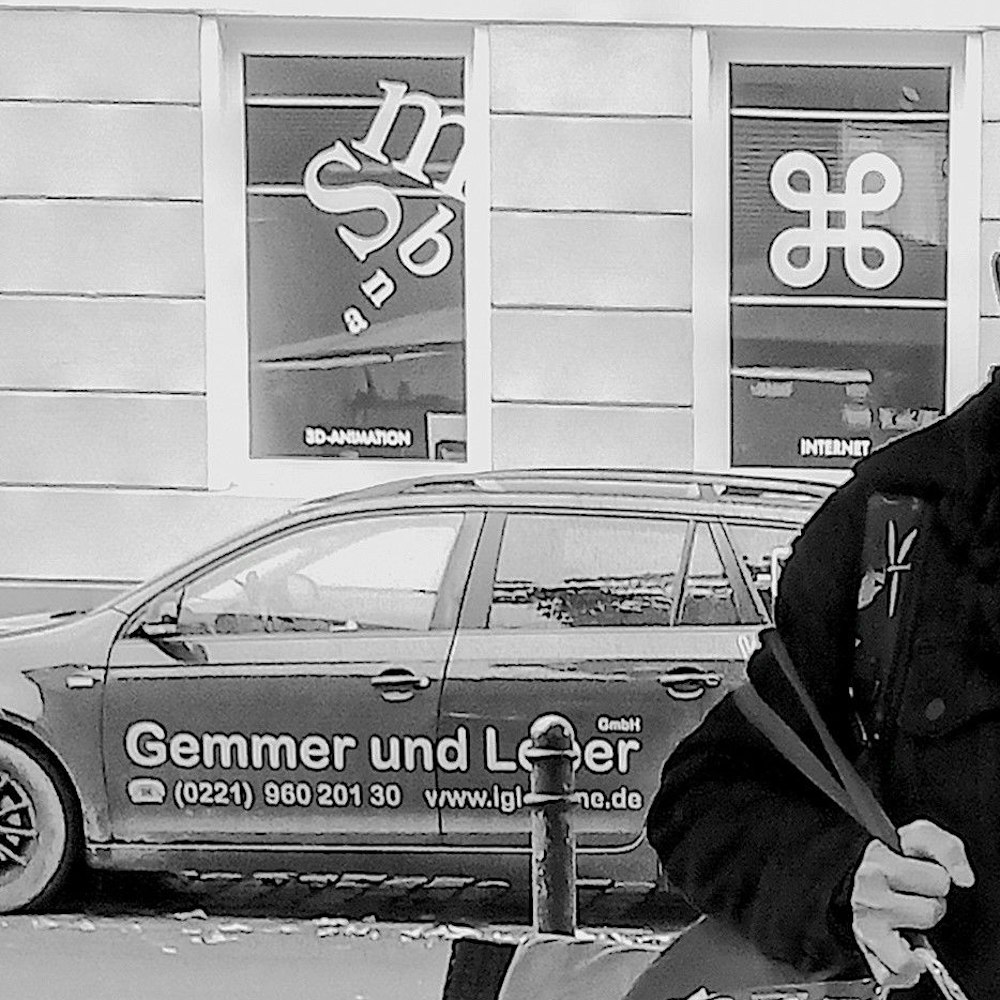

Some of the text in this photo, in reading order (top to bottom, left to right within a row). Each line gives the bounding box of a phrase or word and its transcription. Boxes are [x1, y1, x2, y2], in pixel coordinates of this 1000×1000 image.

[304, 426, 412, 446] 3D-ANIMATION
[800, 438, 871, 457] INTERNET
[597, 715, 642, 733] GmbH
[125, 719, 357, 772] Gemmer
[369, 726, 468, 772] und
[173, 779, 254, 811] (0221)
[263, 780, 312, 807] 960
[316, 781, 362, 808] 201
[369, 784, 402, 808] 30
